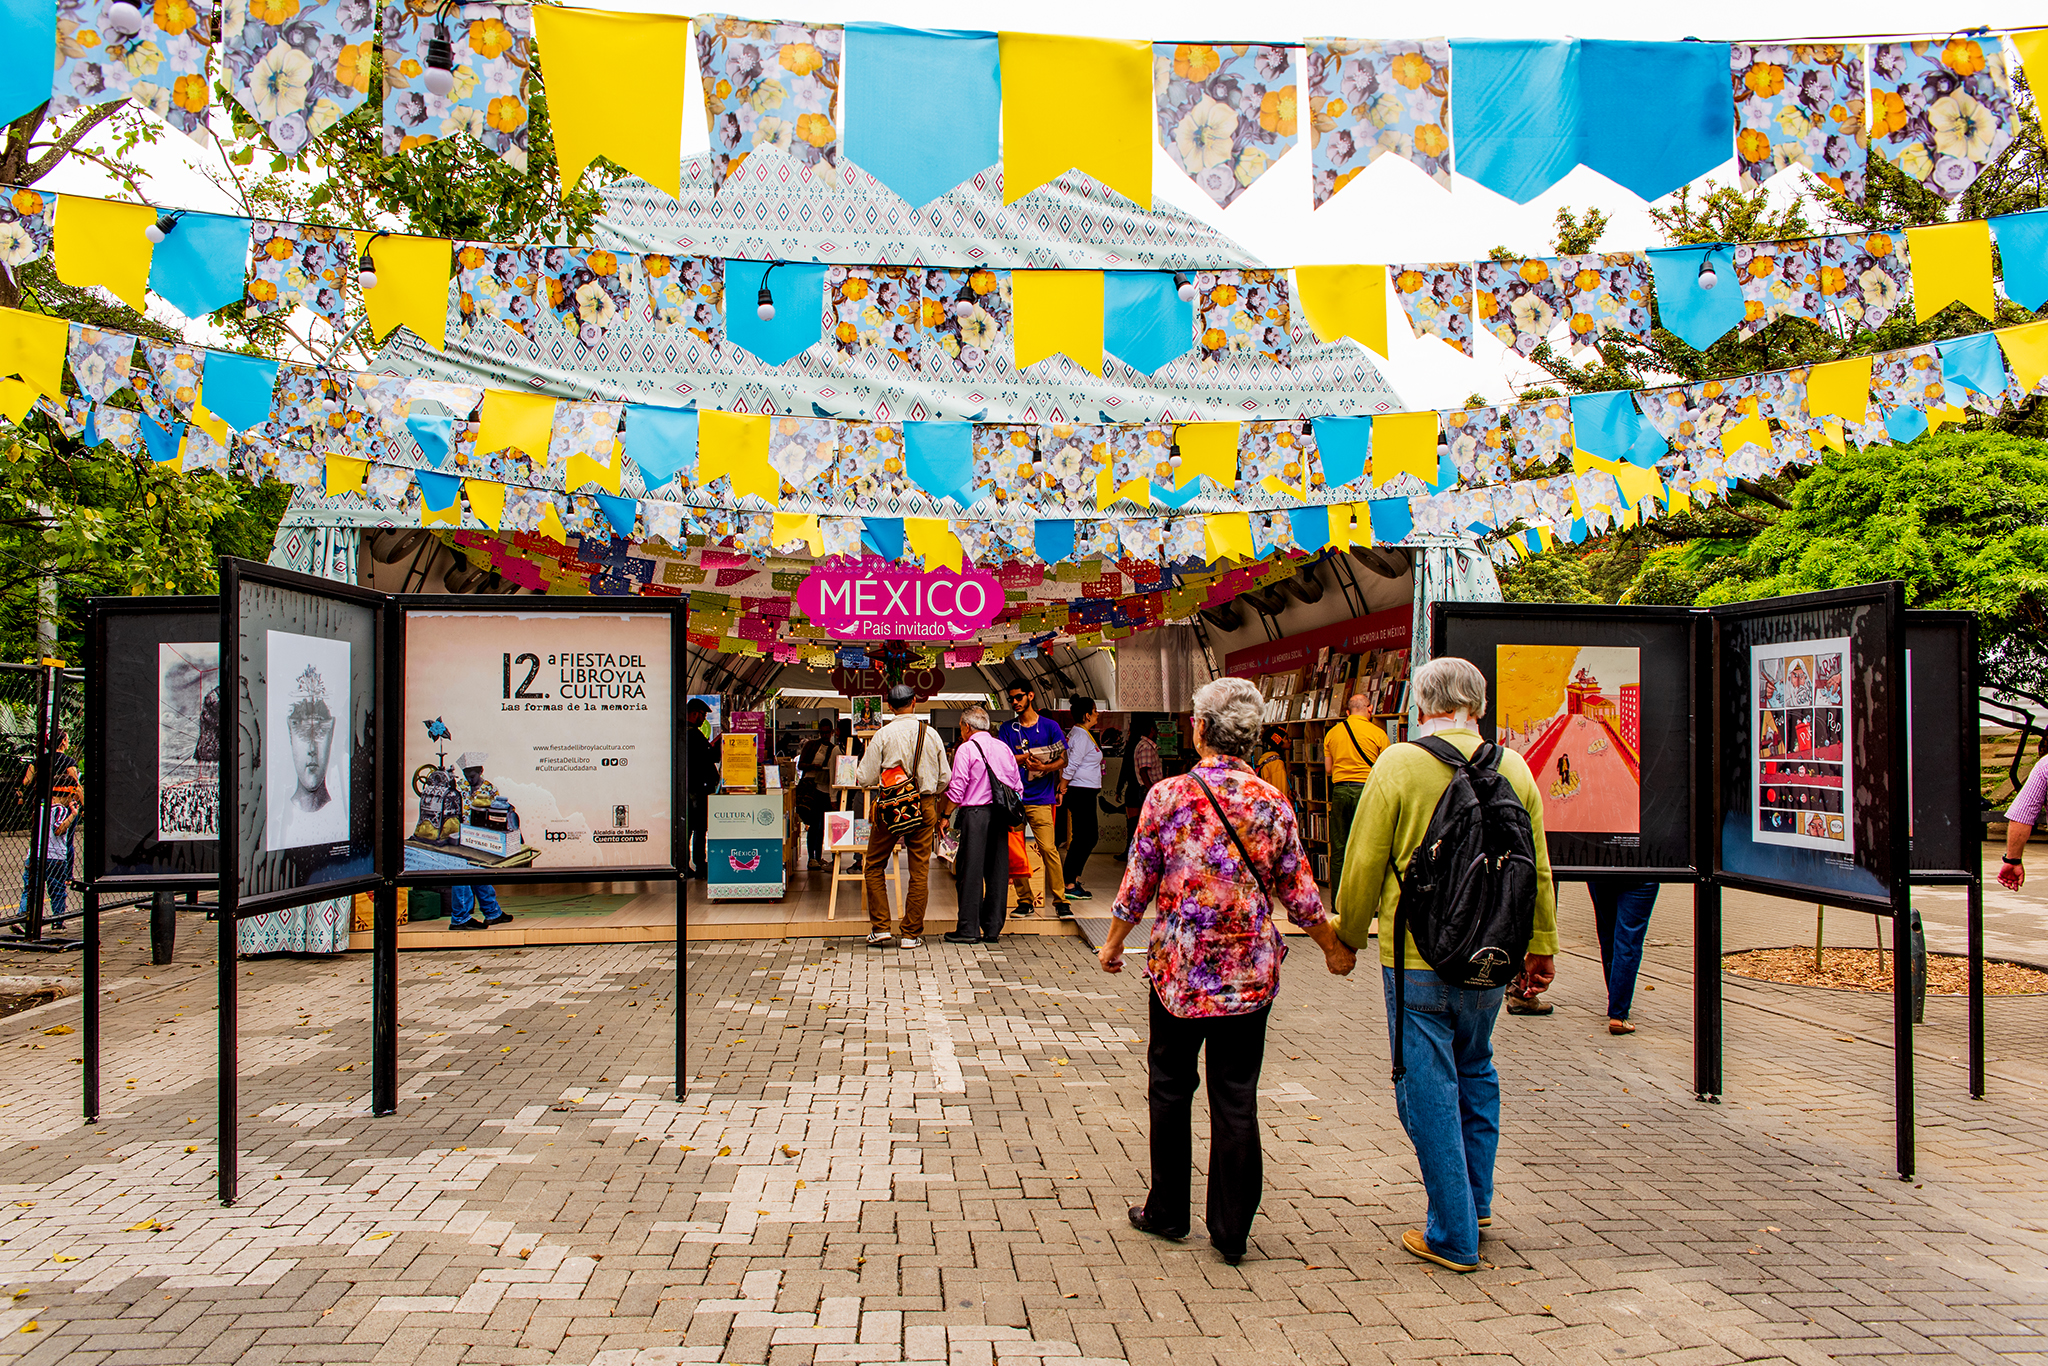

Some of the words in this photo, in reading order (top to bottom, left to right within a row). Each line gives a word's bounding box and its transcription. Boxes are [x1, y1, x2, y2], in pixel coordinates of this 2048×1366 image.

[820, 571, 986, 617] MÉXICO
[863, 621, 891, 636] País
[895, 620, 946, 636] invitado
[1352, 636, 1359, 645] LA
[1359, 631, 1380, 644] MEMORIA
[1380, 629, 1386, 639] DE
[1387, 625, 1406, 637] MÉXICO
[560, 653, 616, 668] FIESTA
[619, 654, 646, 668] DEL
[560, 668, 615, 683] LIBRO
[615, 670, 627, 683] Y
[627, 670, 646, 683] LA
[843, 666, 934, 690] MÉXCO
[559, 684, 646, 699] CULTURA
[501, 703, 520, 711] Las
[524, 703, 563, 711] formas
[567, 703, 580, 711] de
[584, 703, 597, 711] la
[601, 703, 648, 711] memoria
[532, 744, 636, 752] www.fiestadellibroylacultura.com
[713, 811, 752, 819] CULTURA
